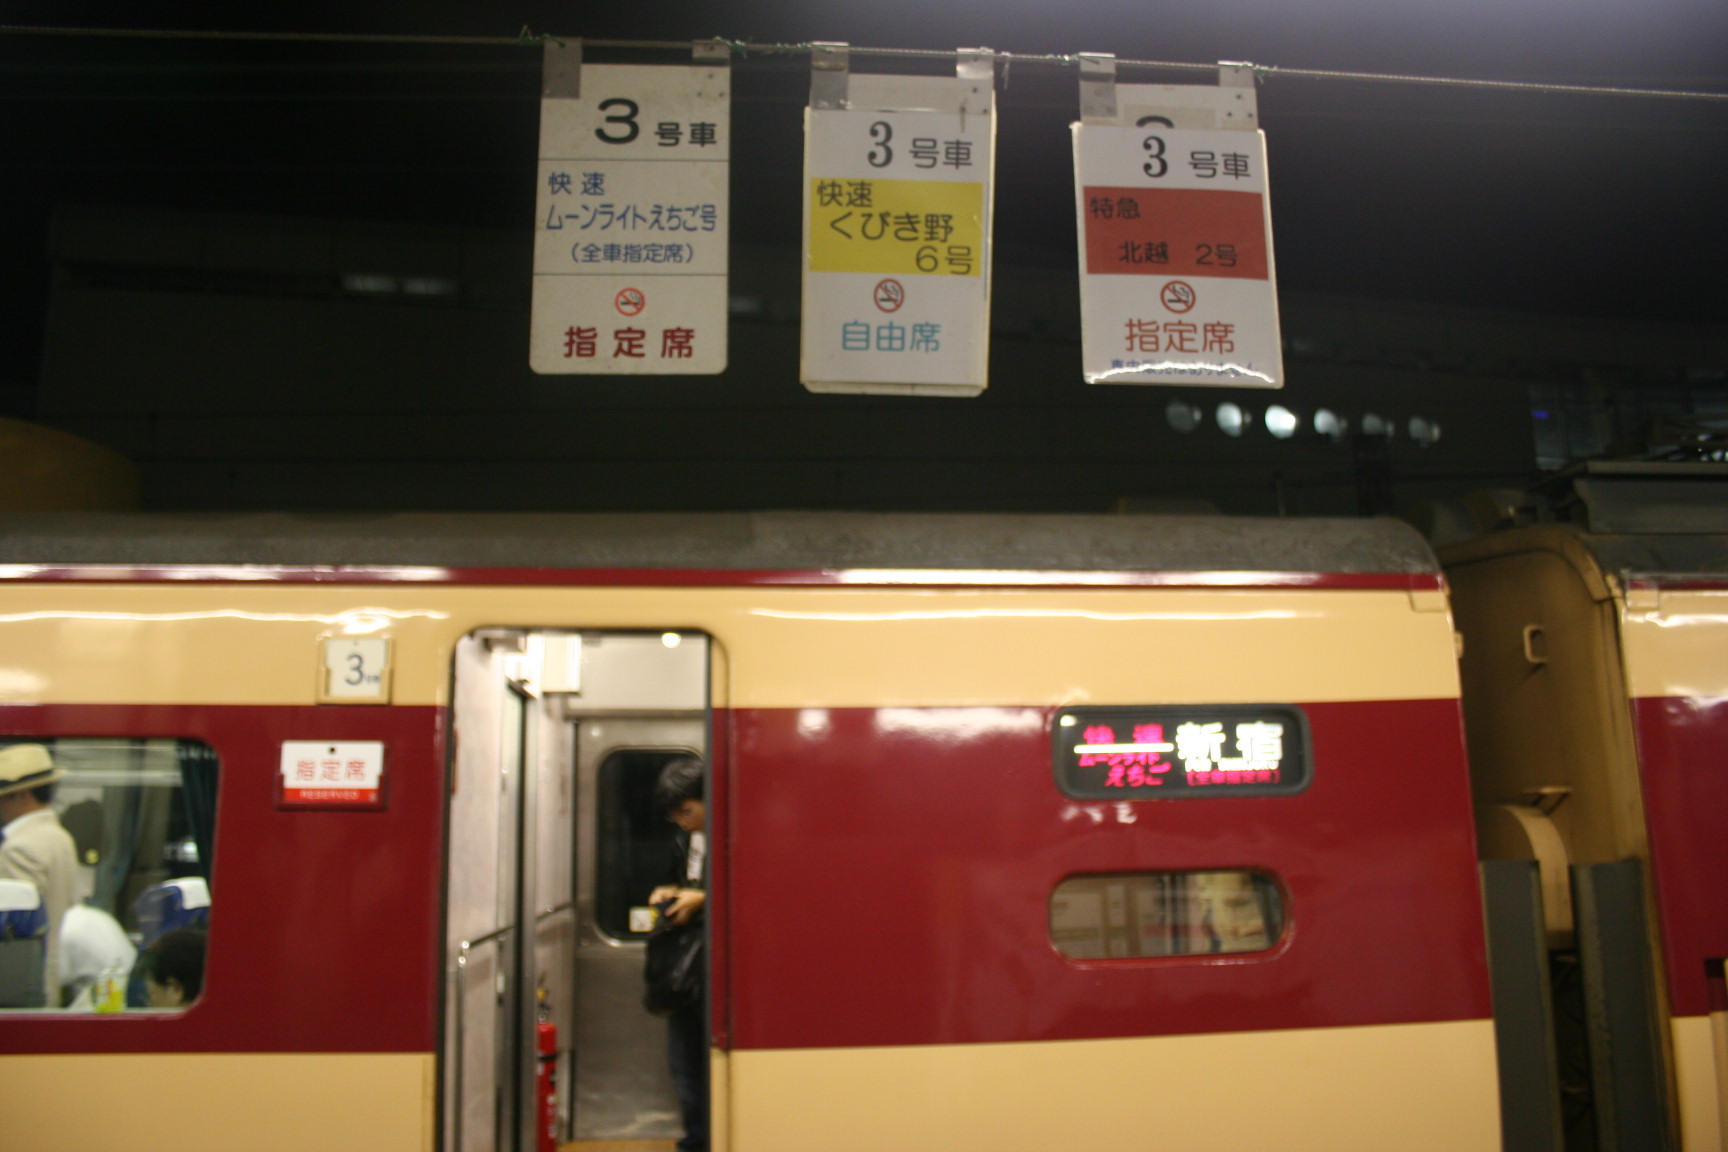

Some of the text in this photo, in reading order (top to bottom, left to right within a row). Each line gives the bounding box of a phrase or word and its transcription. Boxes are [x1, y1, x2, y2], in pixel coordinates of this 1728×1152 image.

[548, 171, 606, 196] 快速
[816, 180, 873, 208] 快速
[545, 204, 718, 232] ムーンライトえちご号
[1090, 196, 1141, 220] 特急
[829, 211, 954, 244] くびき野
[915, 245, 974, 276] 6号
[1118, 241, 1238, 267] 北越 2号
[563, 326, 695, 358] 指定席
[841, 320, 941, 353] 自由席
[1124, 317, 1235, 355] 指定席
[295, 759, 366, 782] 指定席
[299, 789, 361, 800] RESERVED
